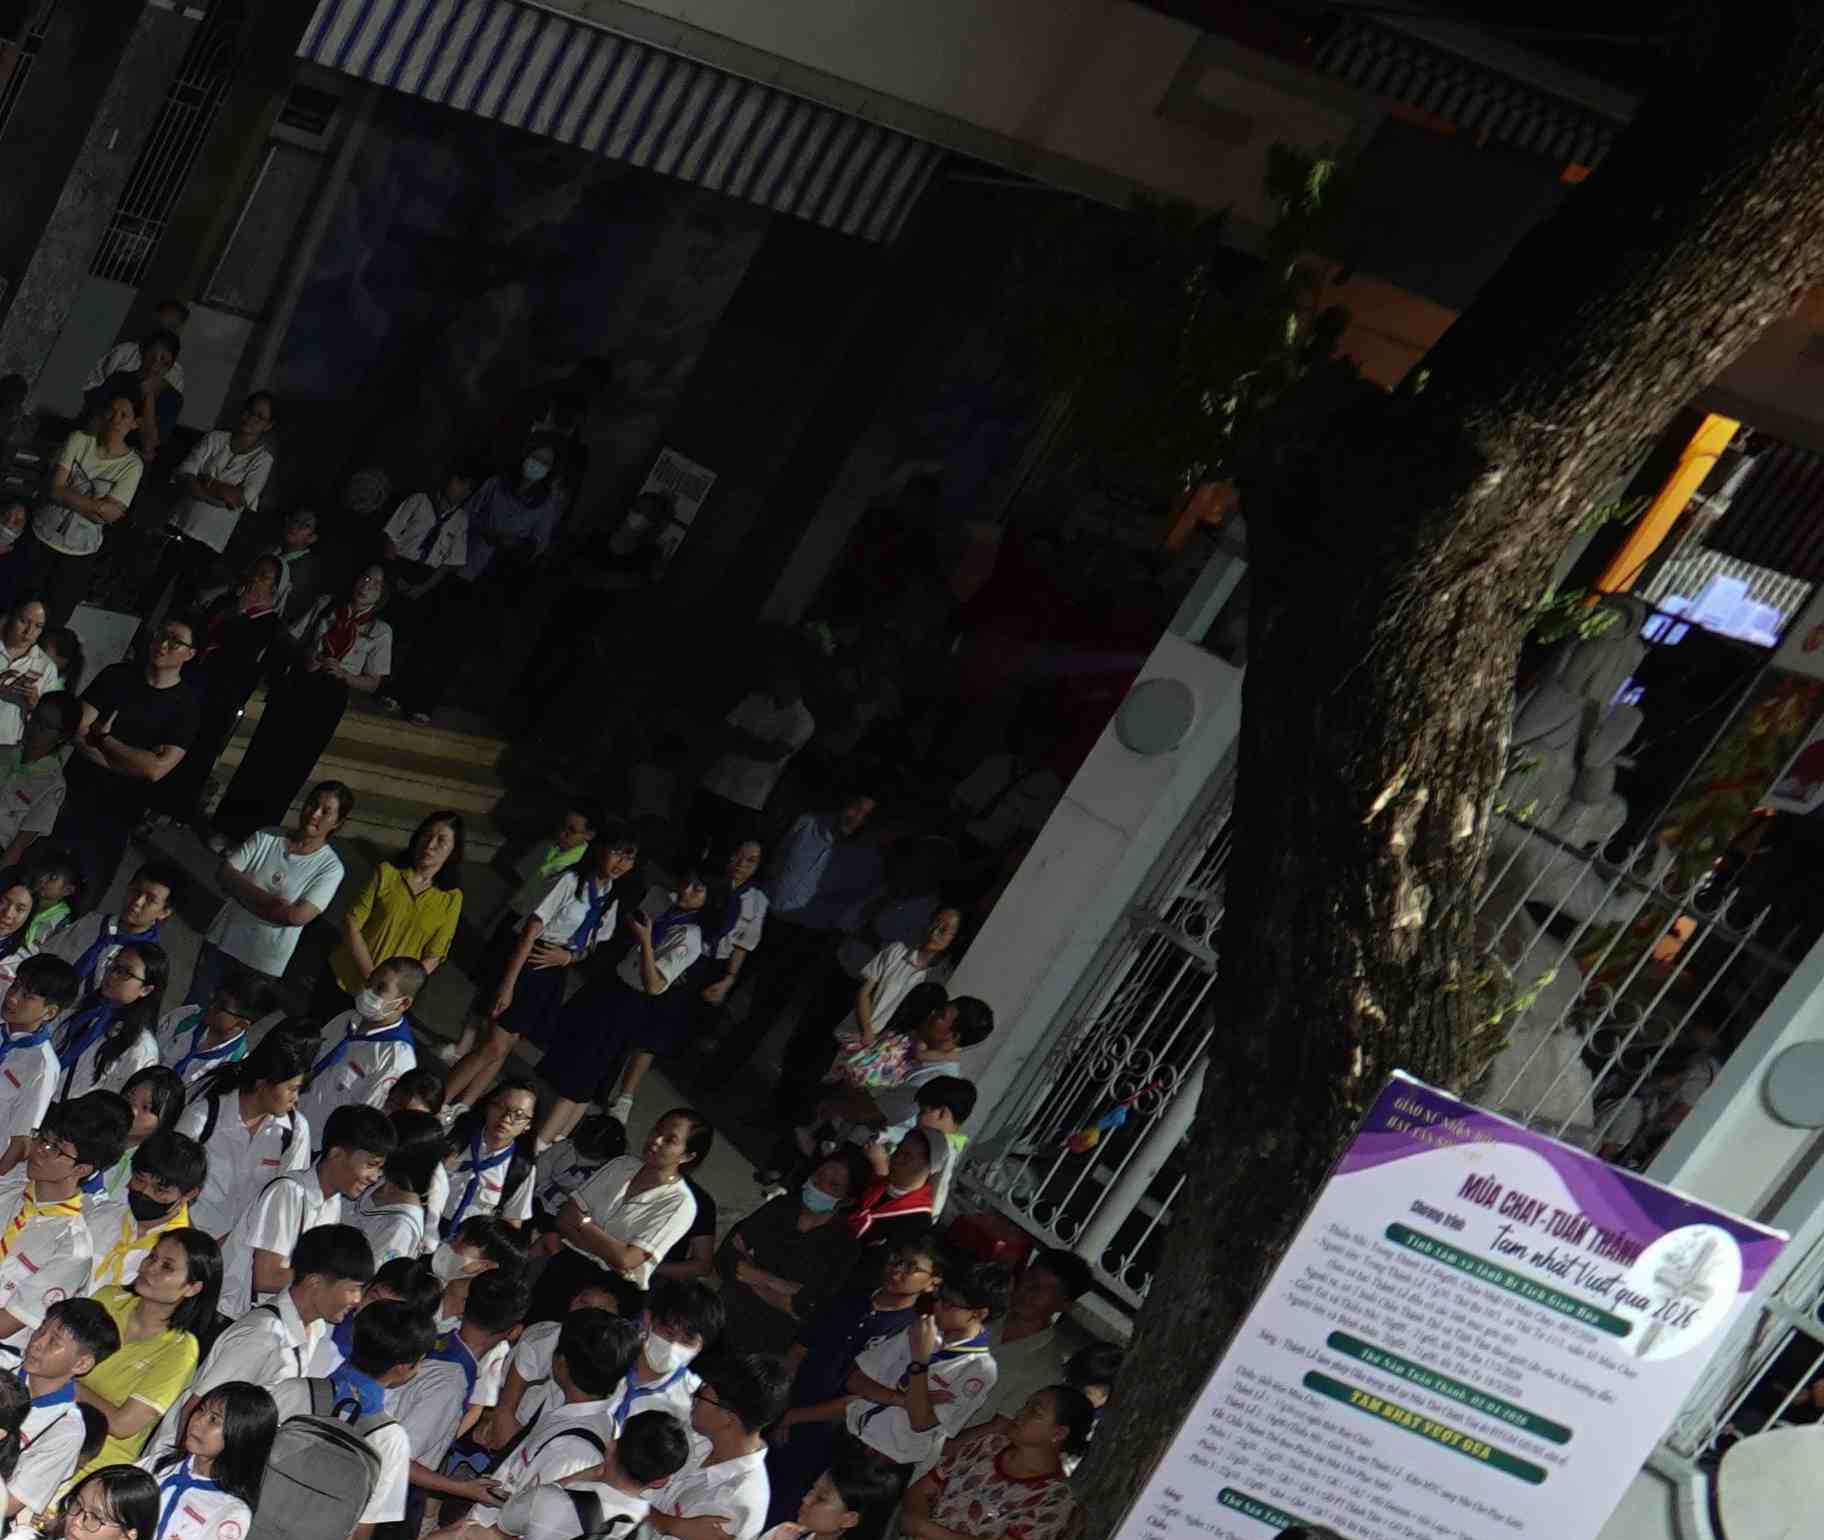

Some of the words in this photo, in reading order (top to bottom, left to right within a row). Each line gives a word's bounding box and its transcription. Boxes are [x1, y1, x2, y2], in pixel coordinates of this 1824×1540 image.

[1458, 1171, 1504, 1209] MÙA
[1487, 1222, 1529, 1260] Tam
[1608, 1286, 1652, 1314] qua
[1653, 1294, 1699, 1329] 2026
[1348, 1390, 1382, 1412] TAM
